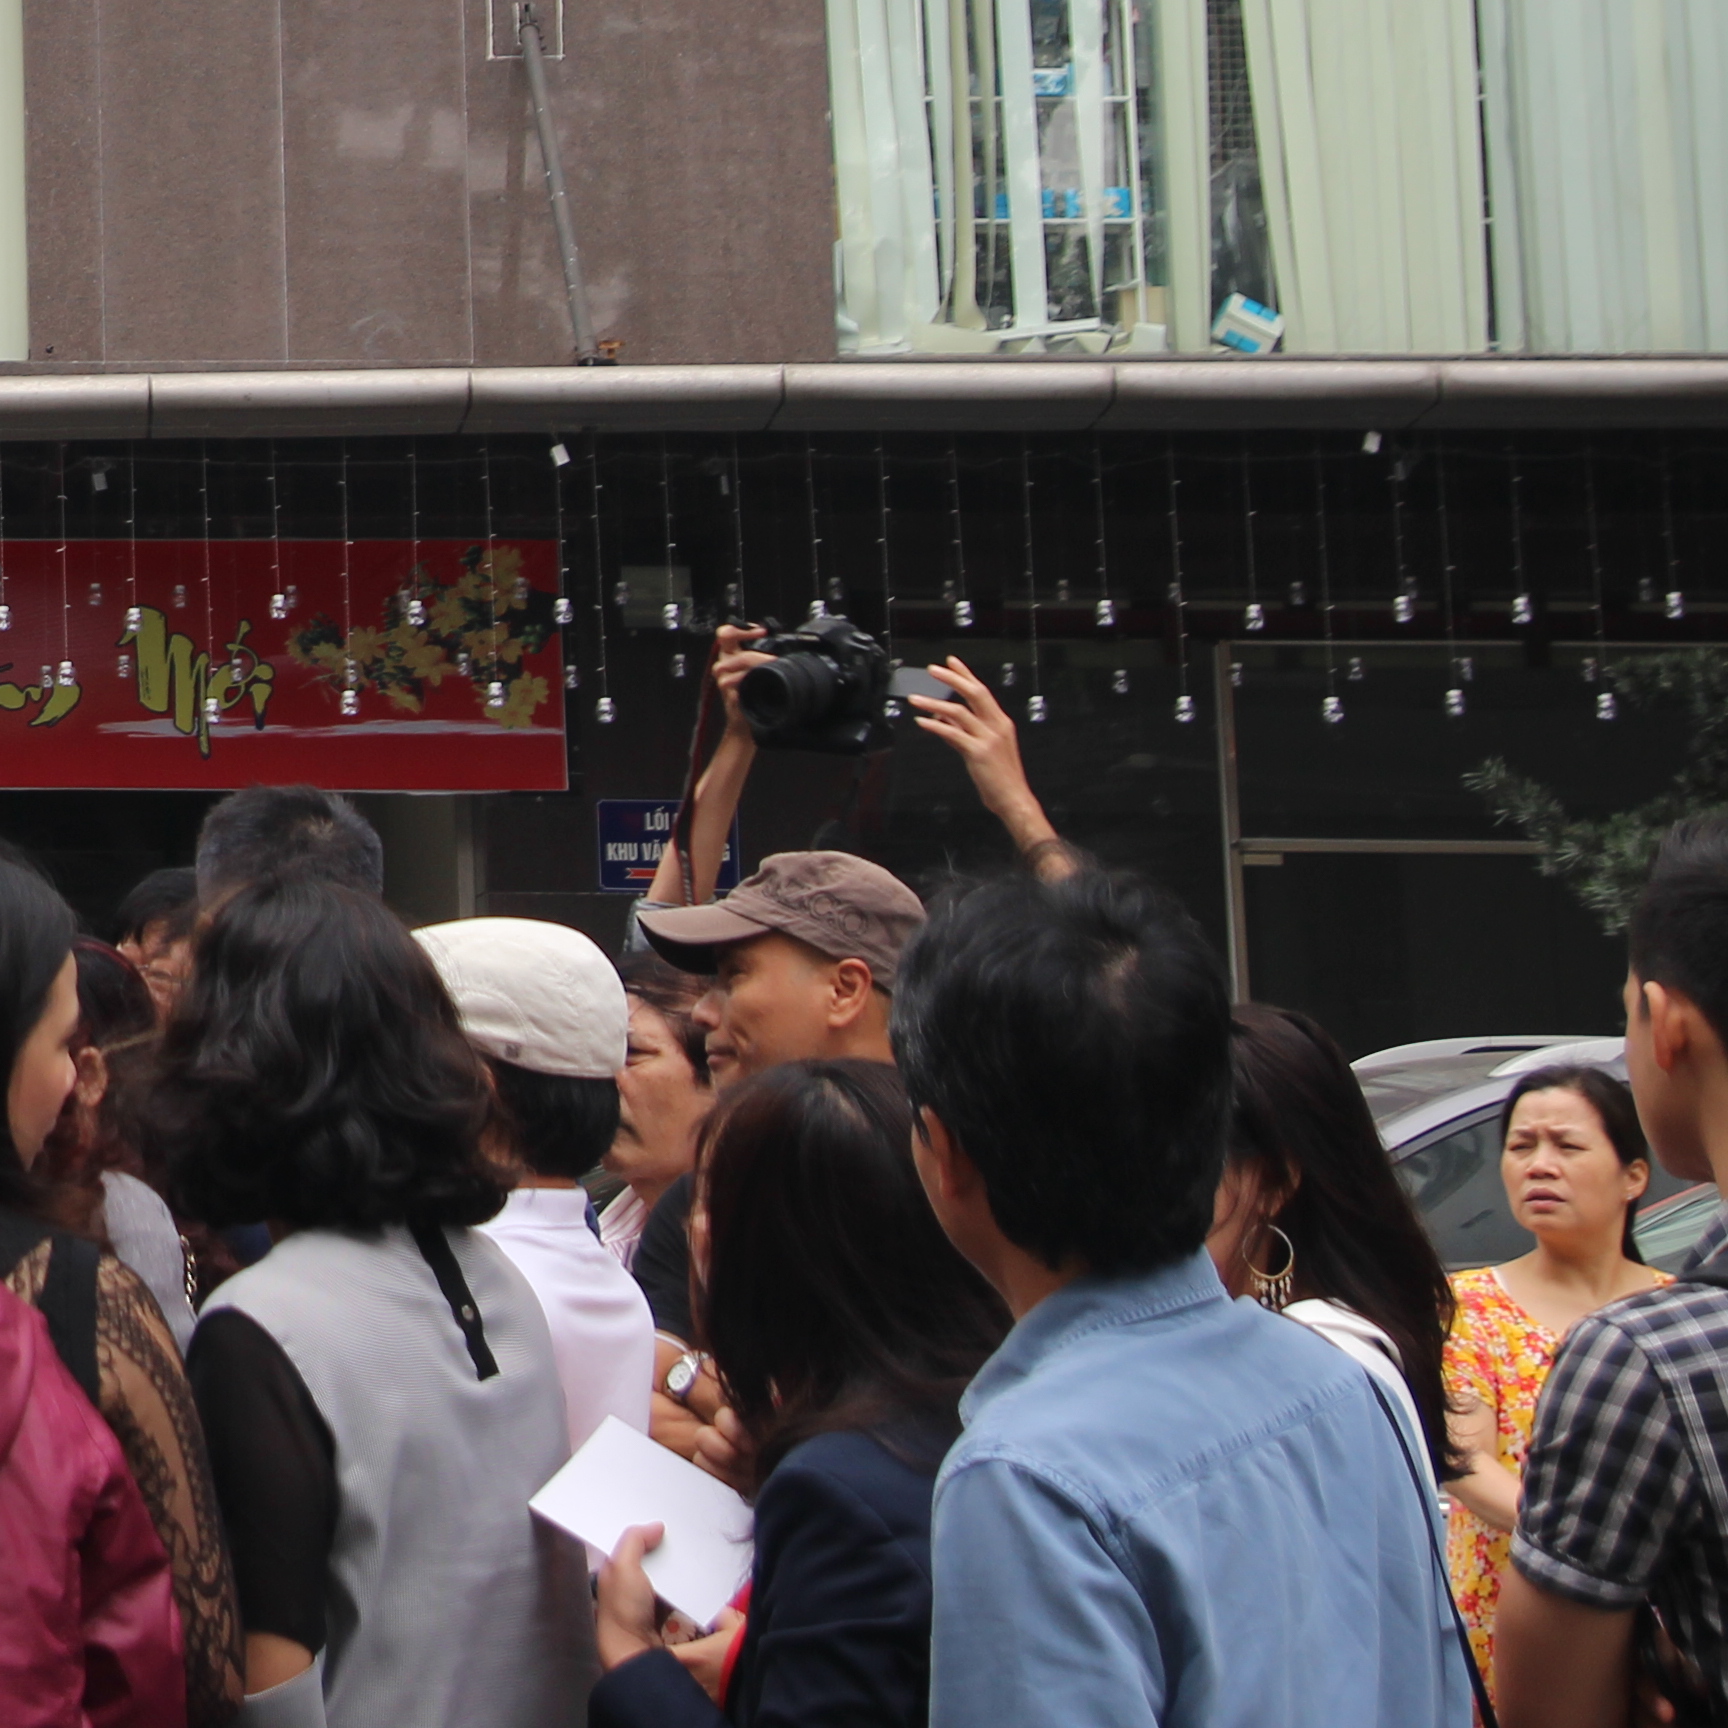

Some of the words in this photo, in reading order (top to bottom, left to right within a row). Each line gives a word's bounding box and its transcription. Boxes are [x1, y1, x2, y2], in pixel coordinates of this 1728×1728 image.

[116, 606, 275, 760] Mới
[644, 806, 670, 831] LỐI
[605, 842, 639, 861] KHU
